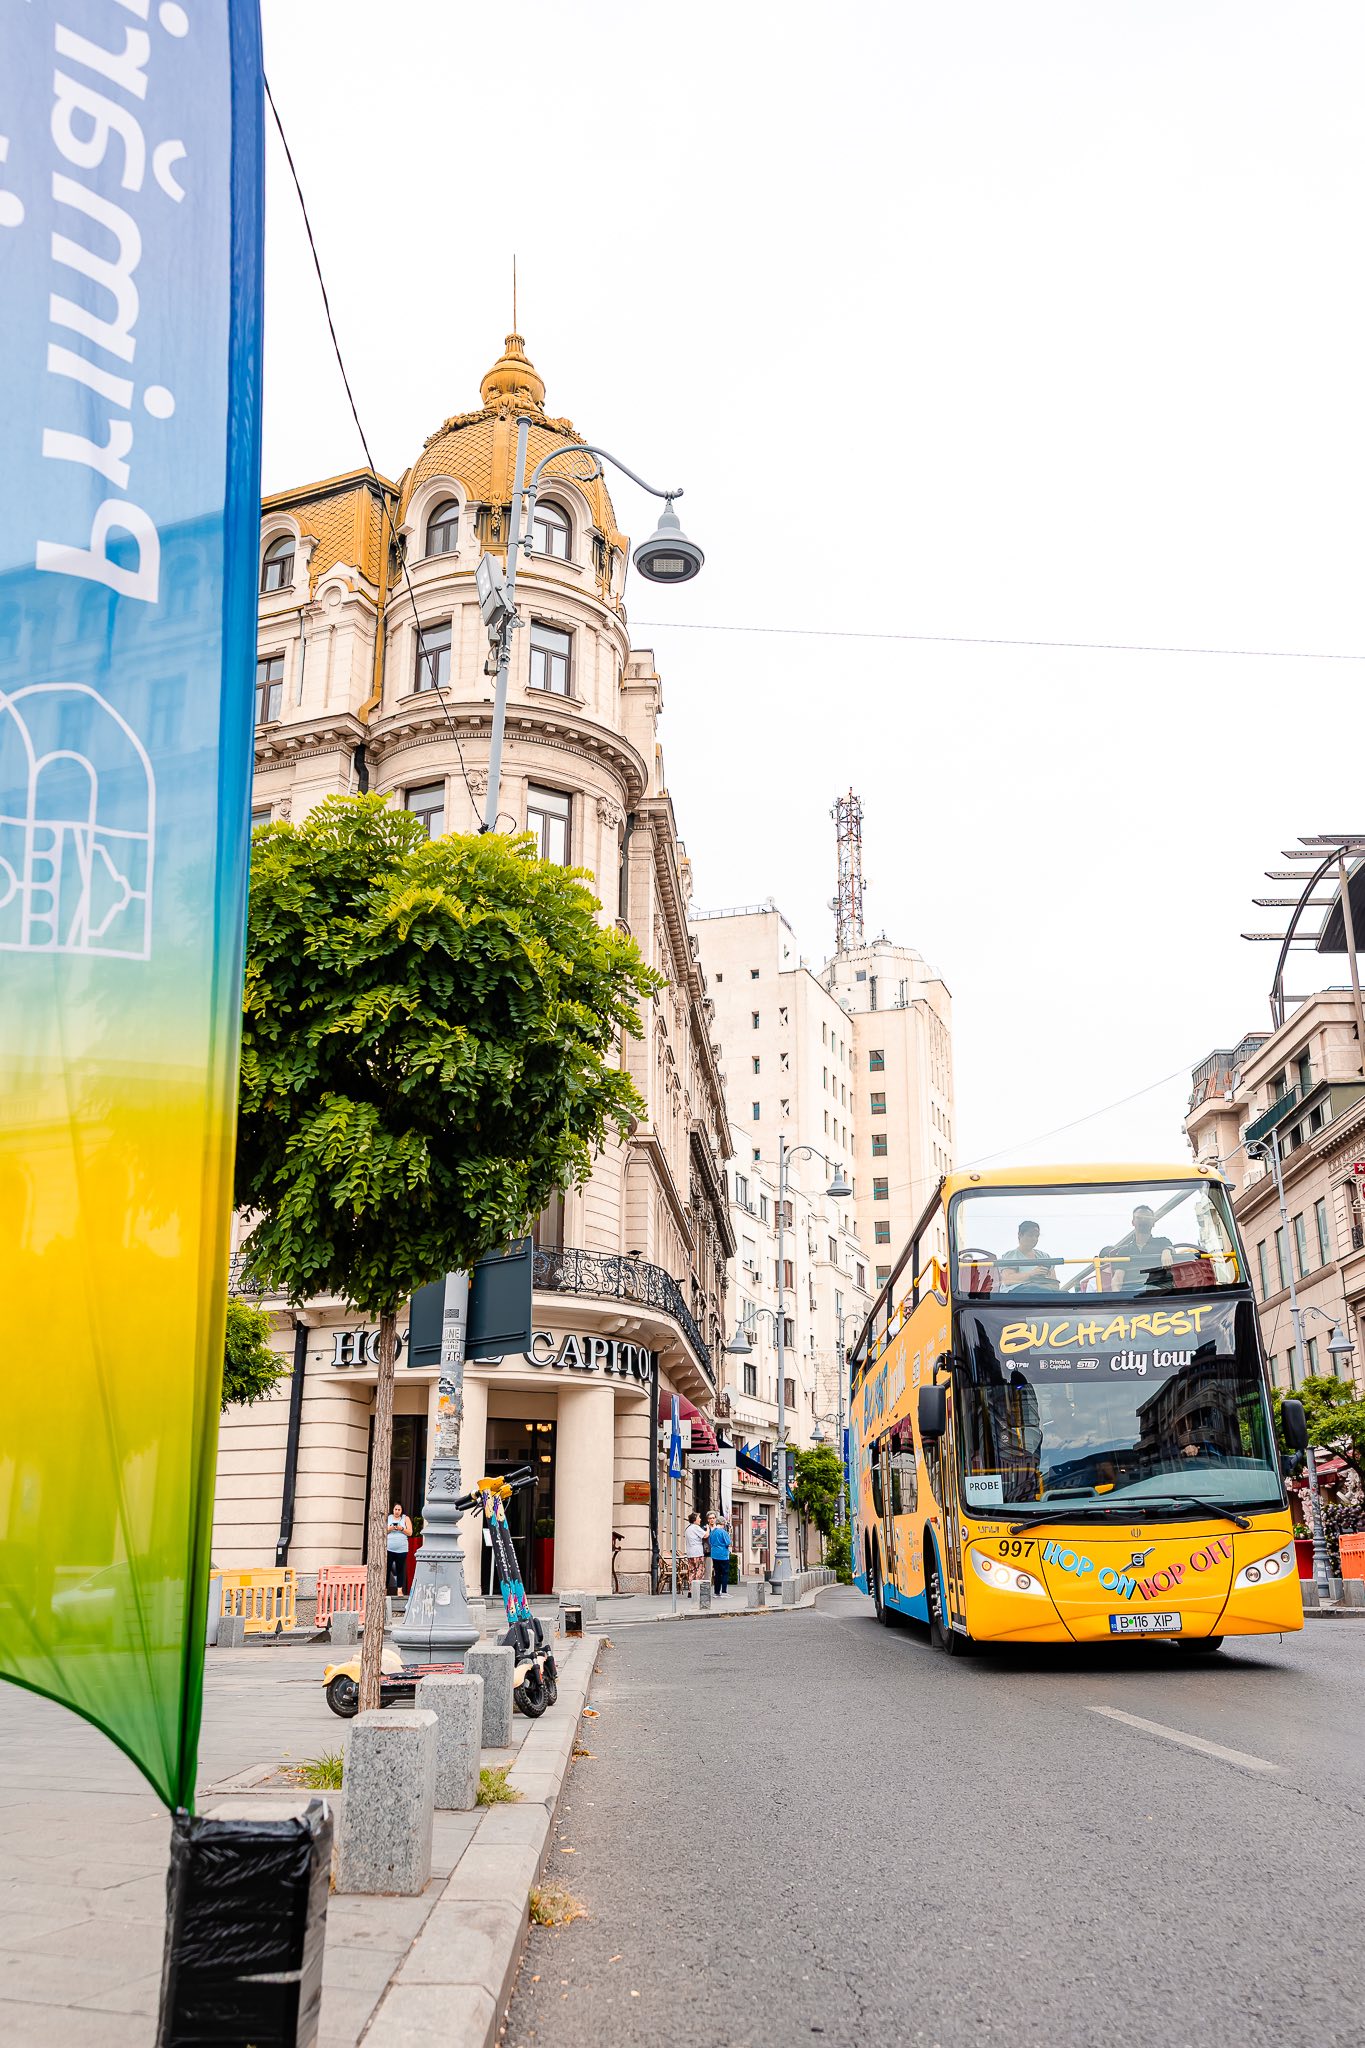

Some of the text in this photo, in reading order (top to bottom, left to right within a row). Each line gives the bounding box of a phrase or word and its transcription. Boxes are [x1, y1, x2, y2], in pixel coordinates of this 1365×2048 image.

[999, 1305, 1213, 1354] BUCHAREST
[1110, 1348, 1197, 1376] city tour
[969, 1481, 999, 1491] PROBE
[998, 1539, 1036, 1557] 997
[1043, 1536, 1233, 1601] HOP ON HOP OFF
[1133, 1615, 1149, 1628] 116
[1153, 1614, 1173, 1628] XIP
